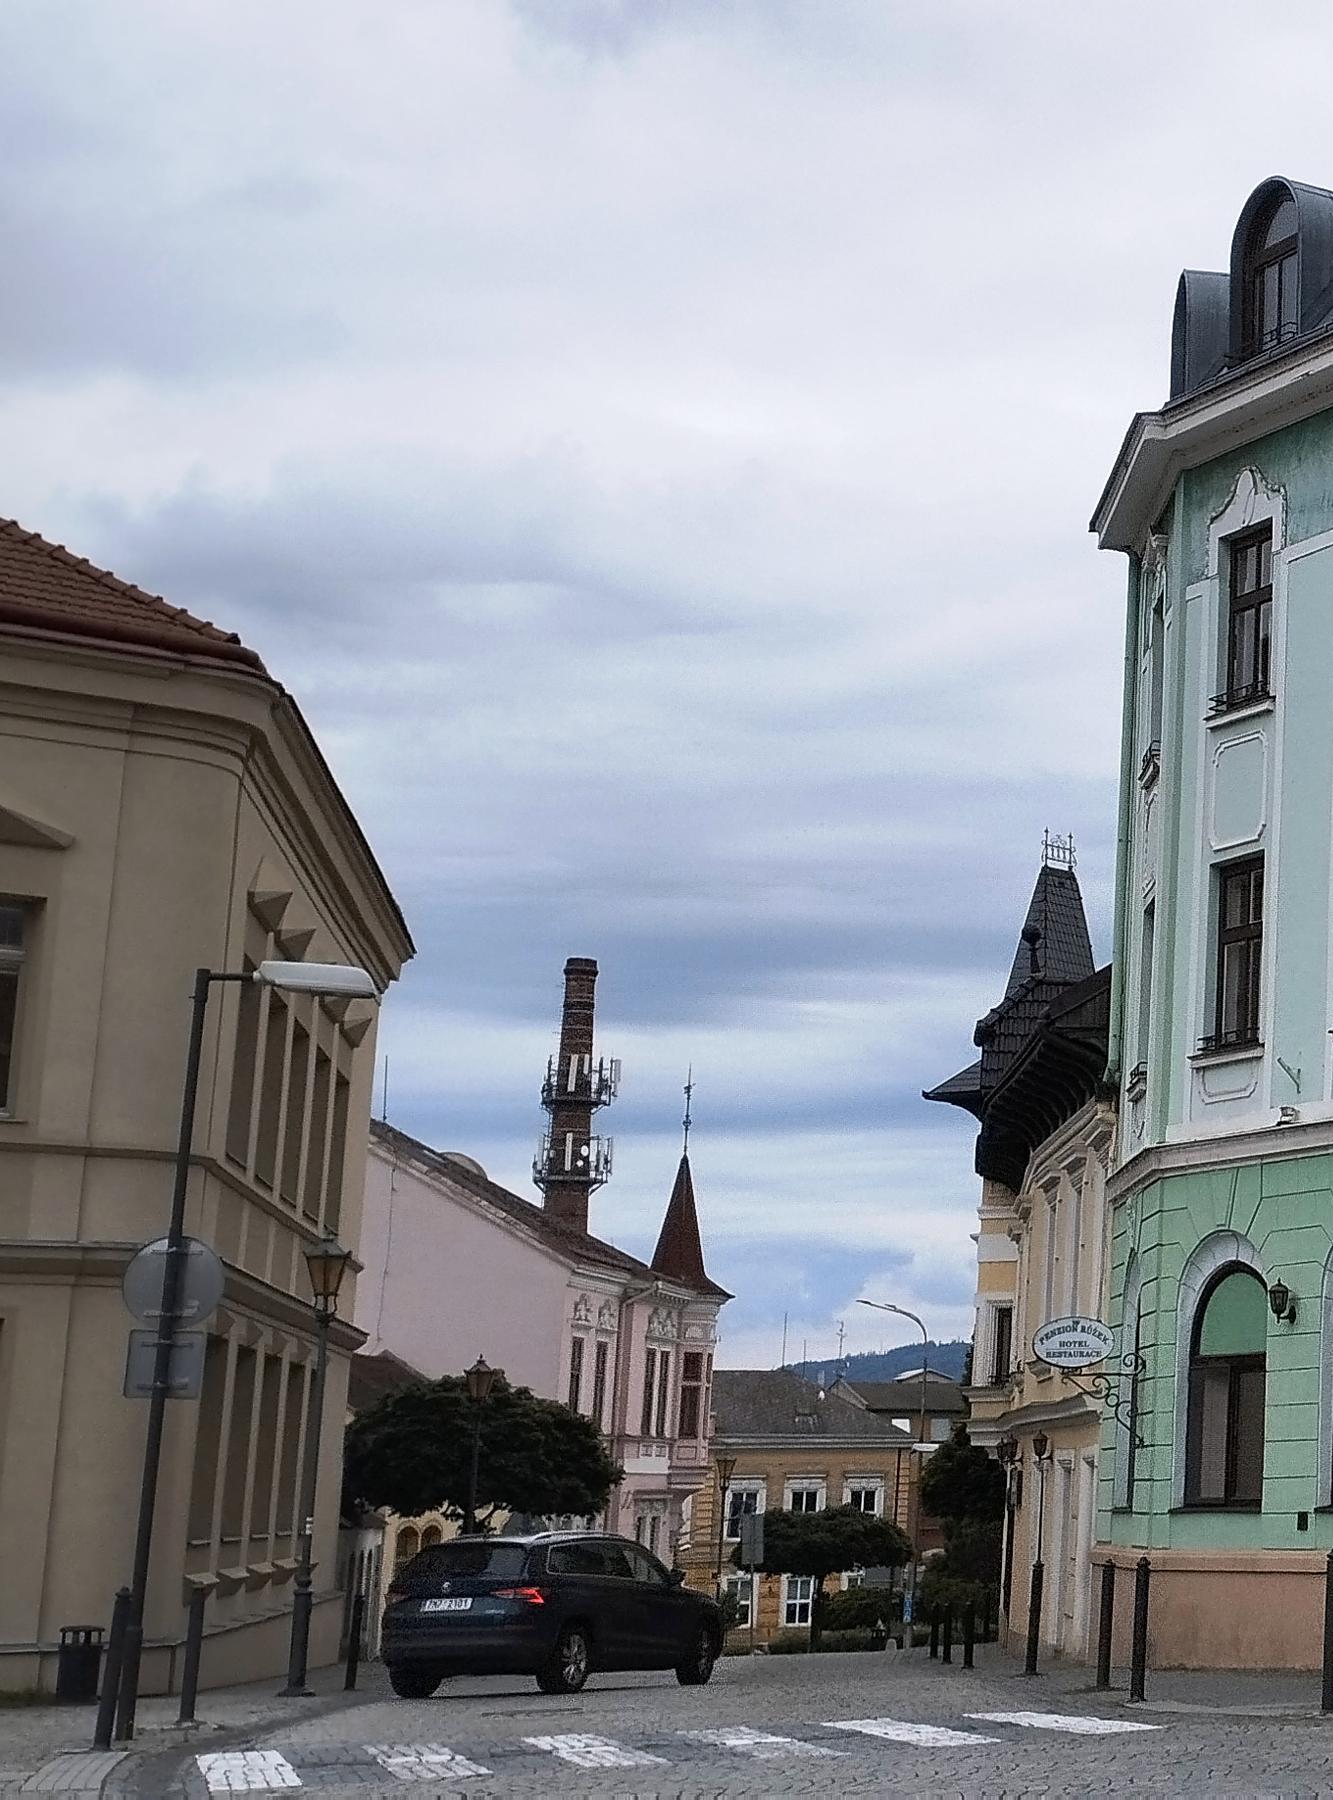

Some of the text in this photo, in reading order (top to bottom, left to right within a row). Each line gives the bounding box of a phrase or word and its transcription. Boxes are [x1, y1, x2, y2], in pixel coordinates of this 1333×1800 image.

[1039, 1324, 1079, 1345] PENZION
[1058, 1340, 1090, 1348] HOTEL
[1045, 1350, 1102, 1359] RESTAURACE
